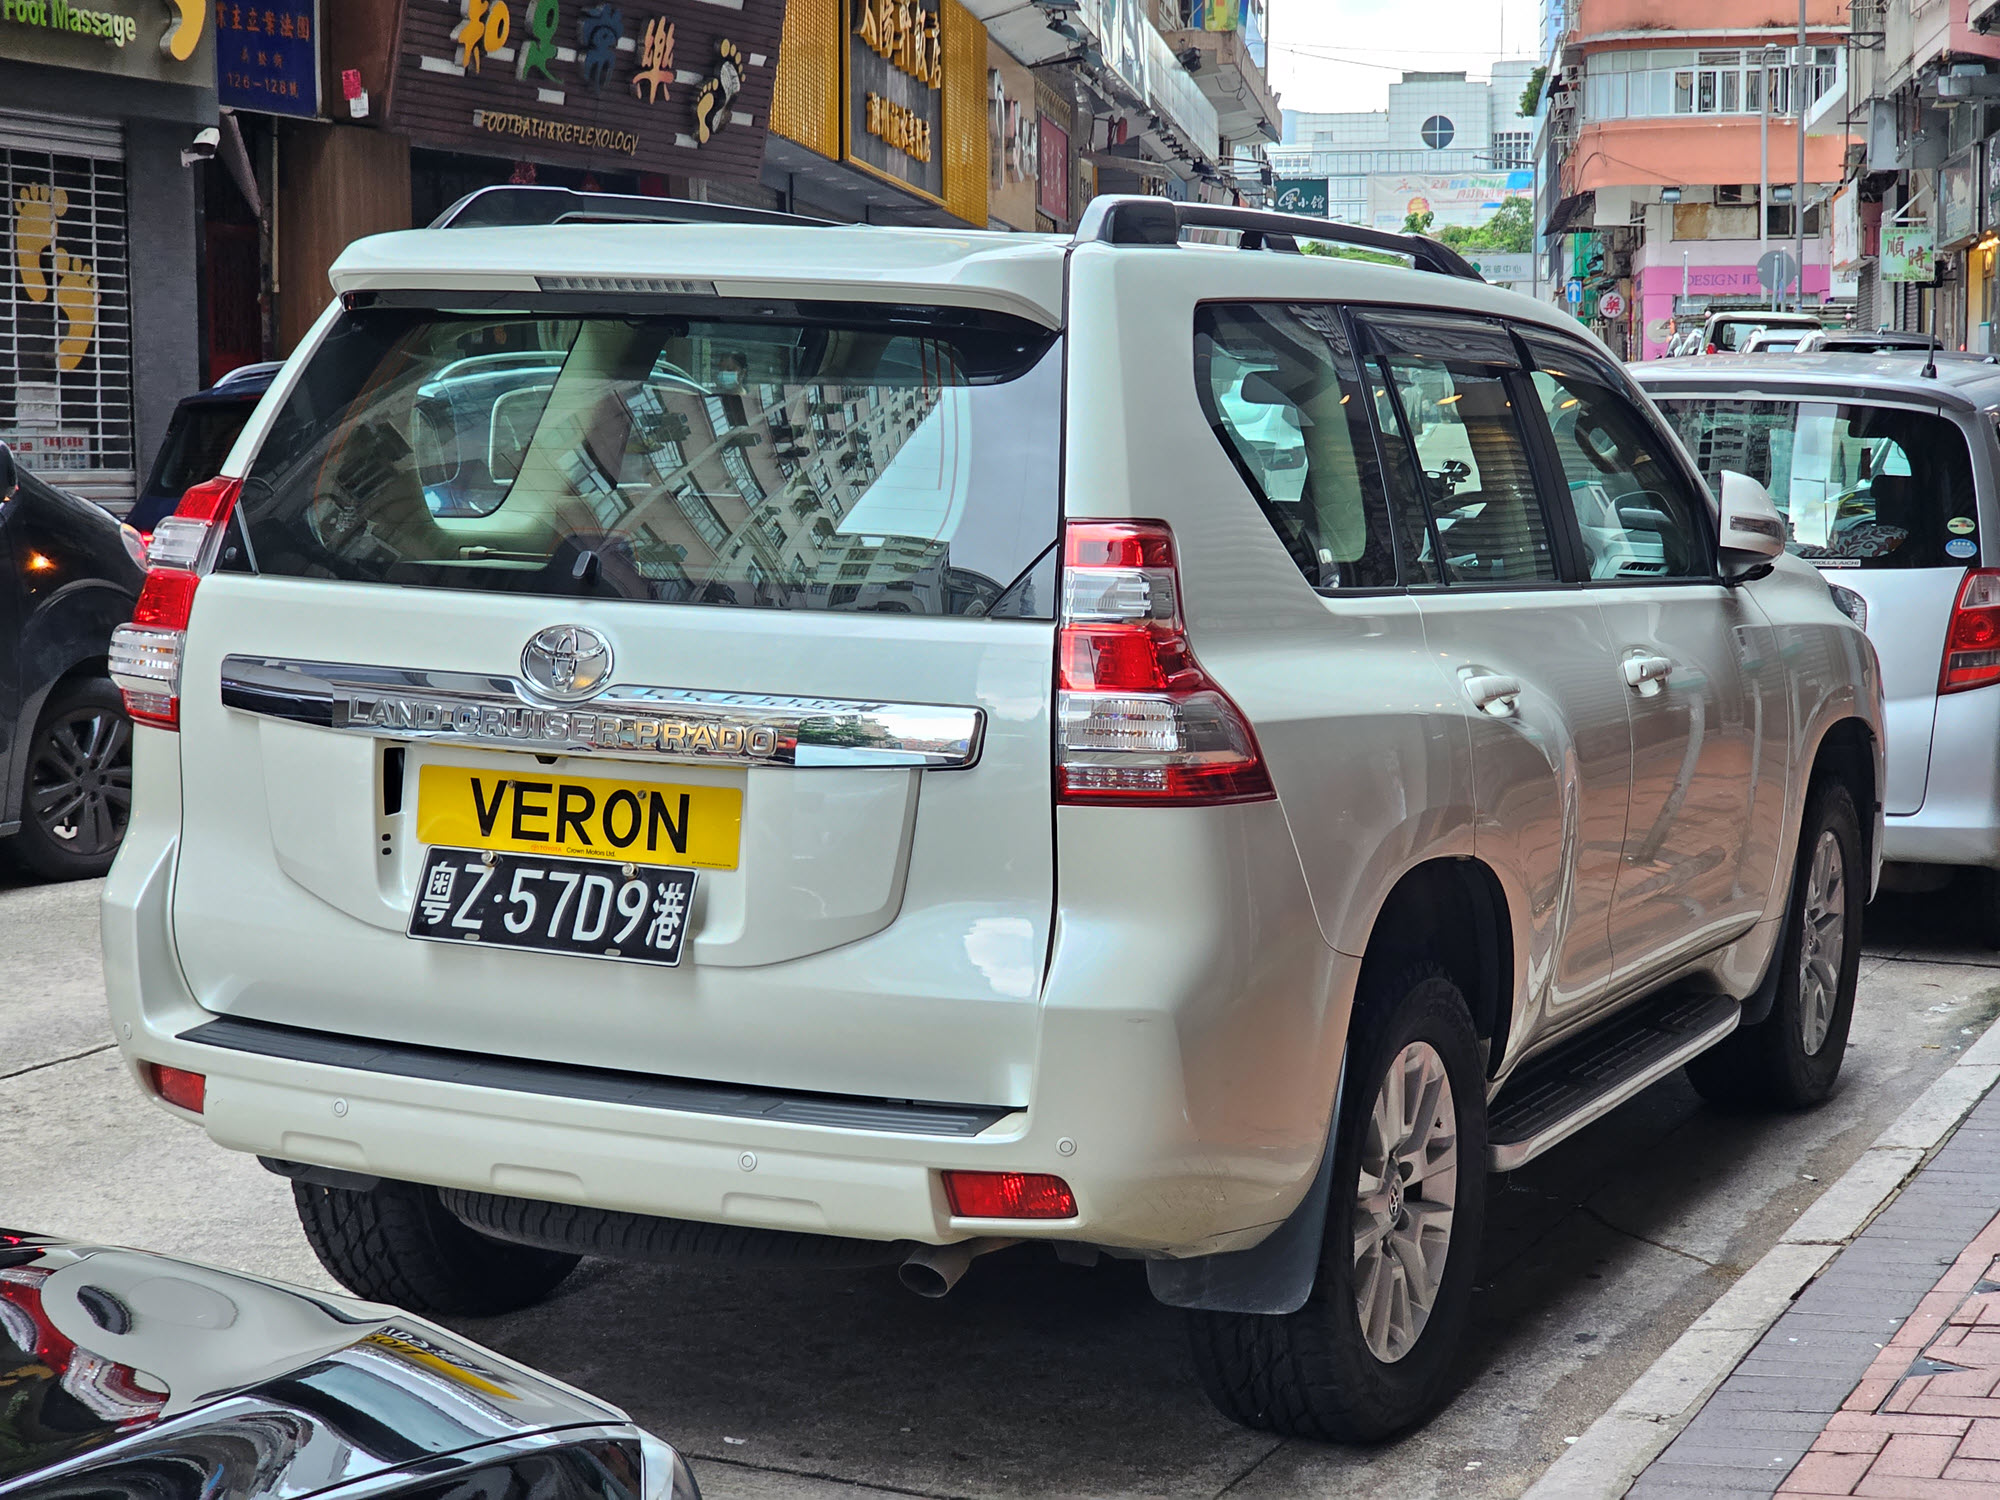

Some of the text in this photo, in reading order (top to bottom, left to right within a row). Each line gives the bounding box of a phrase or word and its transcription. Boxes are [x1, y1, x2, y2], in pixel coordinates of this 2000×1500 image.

[3, 0, 136, 47] Foot Massage
[481, 111, 640, 157] FOOTBATH&REFLEXOLOGY
[349, 696, 778, 757] LAND CRUISER PRADO
[470, 777, 691, 854] VERON
[566, 847, 584, 855] Crown
[586, 848, 605, 857] Motors
[606, 850, 616, 858] Ltd.
